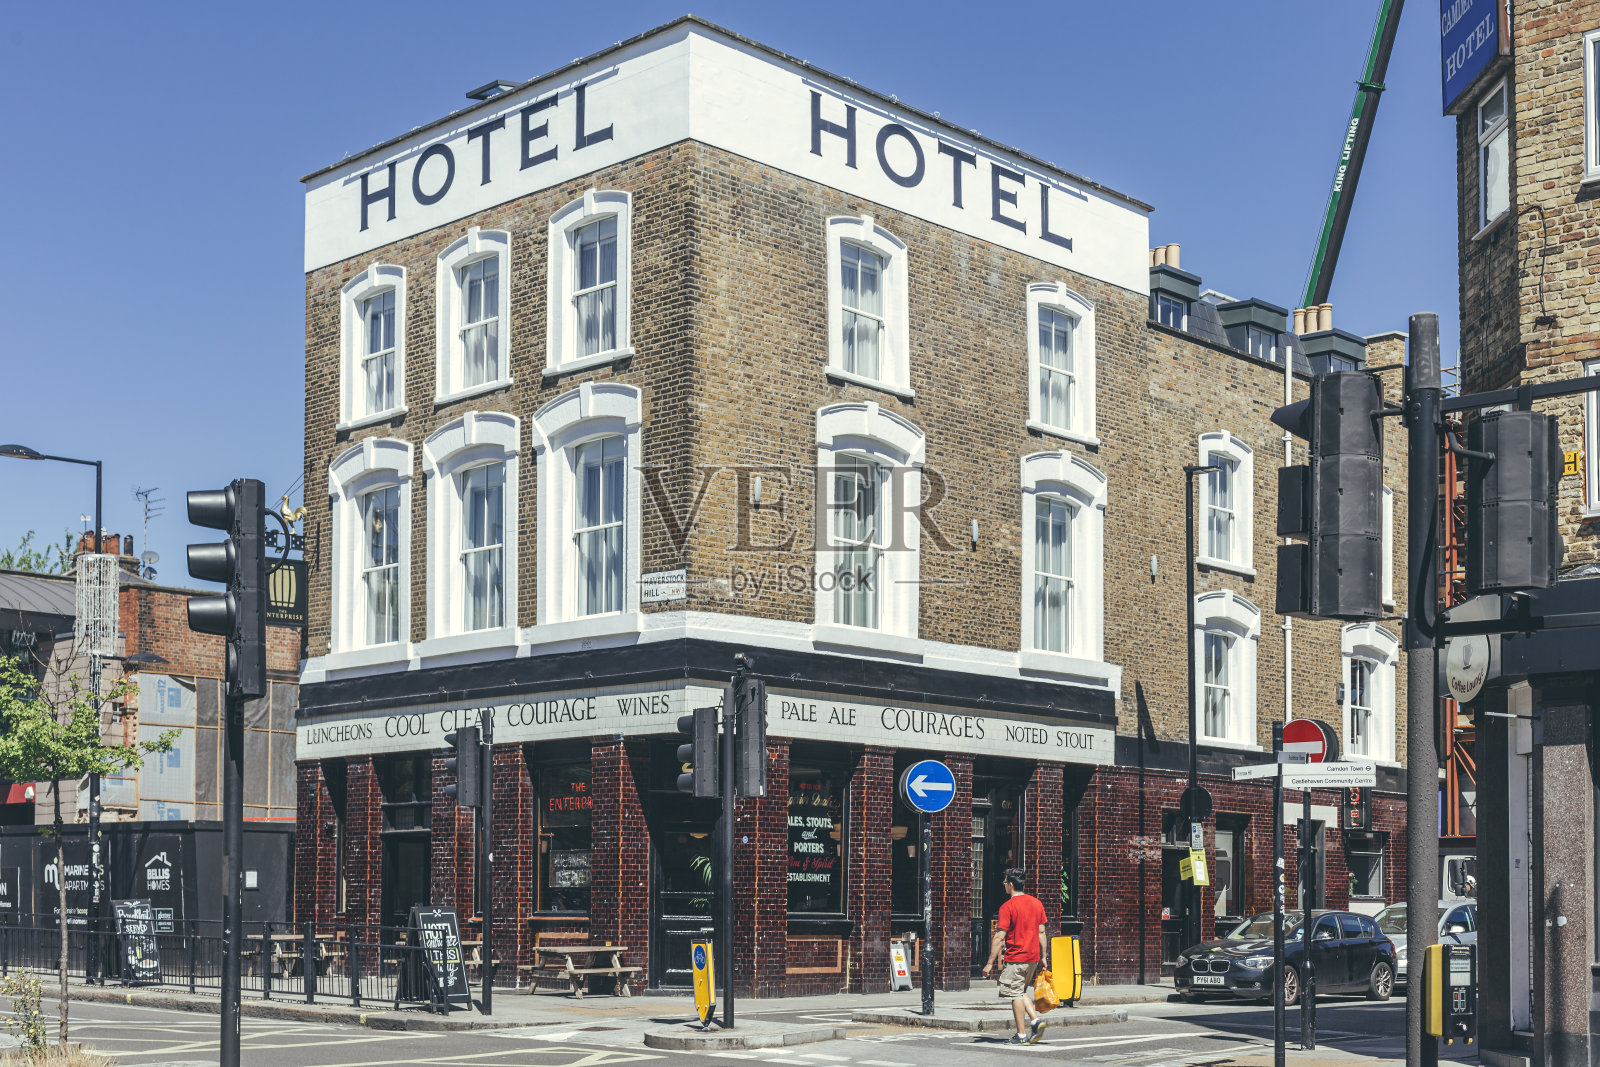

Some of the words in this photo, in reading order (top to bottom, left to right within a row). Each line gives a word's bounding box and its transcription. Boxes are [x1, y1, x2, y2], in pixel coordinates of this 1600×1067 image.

[1446, 12, 1494, 82] HOTEL
[360, 83, 613, 232] HOTEL
[1334, 165, 1347, 192] KING
[1342, 118, 1359, 160] LIFTING
[809, 89, 1072, 253] HOTEL
[644, 574, 685, 586] HAVERSTOCK
[644, 588, 660, 597] HILL
[266, 612, 304, 620] NTERPRISE
[1451, 676, 1466, 693] Coffee
[1466, 667, 1484, 692] Lounge
[306, 722, 373, 745] LUNCHEONS
[385, 713, 430, 738] COOL
[440, 706, 496, 732] CLEAR
[507, 696, 597, 727] COURAGE
[616, 694, 670, 716] WINES
[781, 701, 817, 722] PALE
[828, 706, 857, 726] ALE
[880, 707, 985, 740] COURAGE'S
[1005, 725, 1049, 746] NOTED
[1056, 730, 1095, 750] STOUT
[570, 782, 586, 792] THE
[794, 841, 824, 854] PORTERS
[64, 865, 89, 876] MARINE
[147, 868, 171, 880] BELLIS
[147, 879, 171, 891] HOMES
